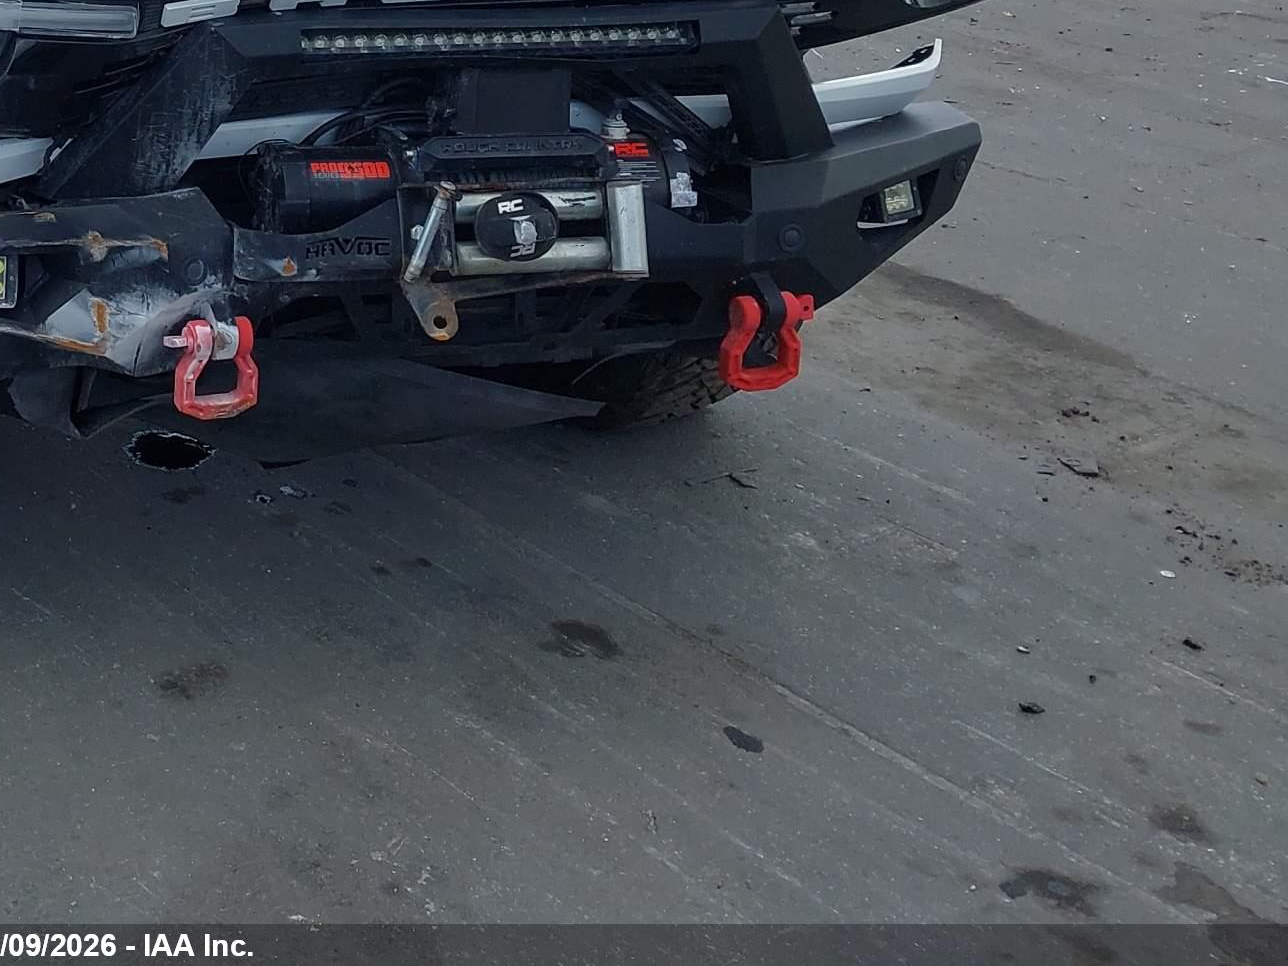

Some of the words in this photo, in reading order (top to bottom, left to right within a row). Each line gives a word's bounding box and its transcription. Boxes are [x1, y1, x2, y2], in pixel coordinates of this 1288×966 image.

[615, 142, 649, 157] RC
[497, 198, 524, 214] RC
[305, 236, 392, 259] HAVOC
